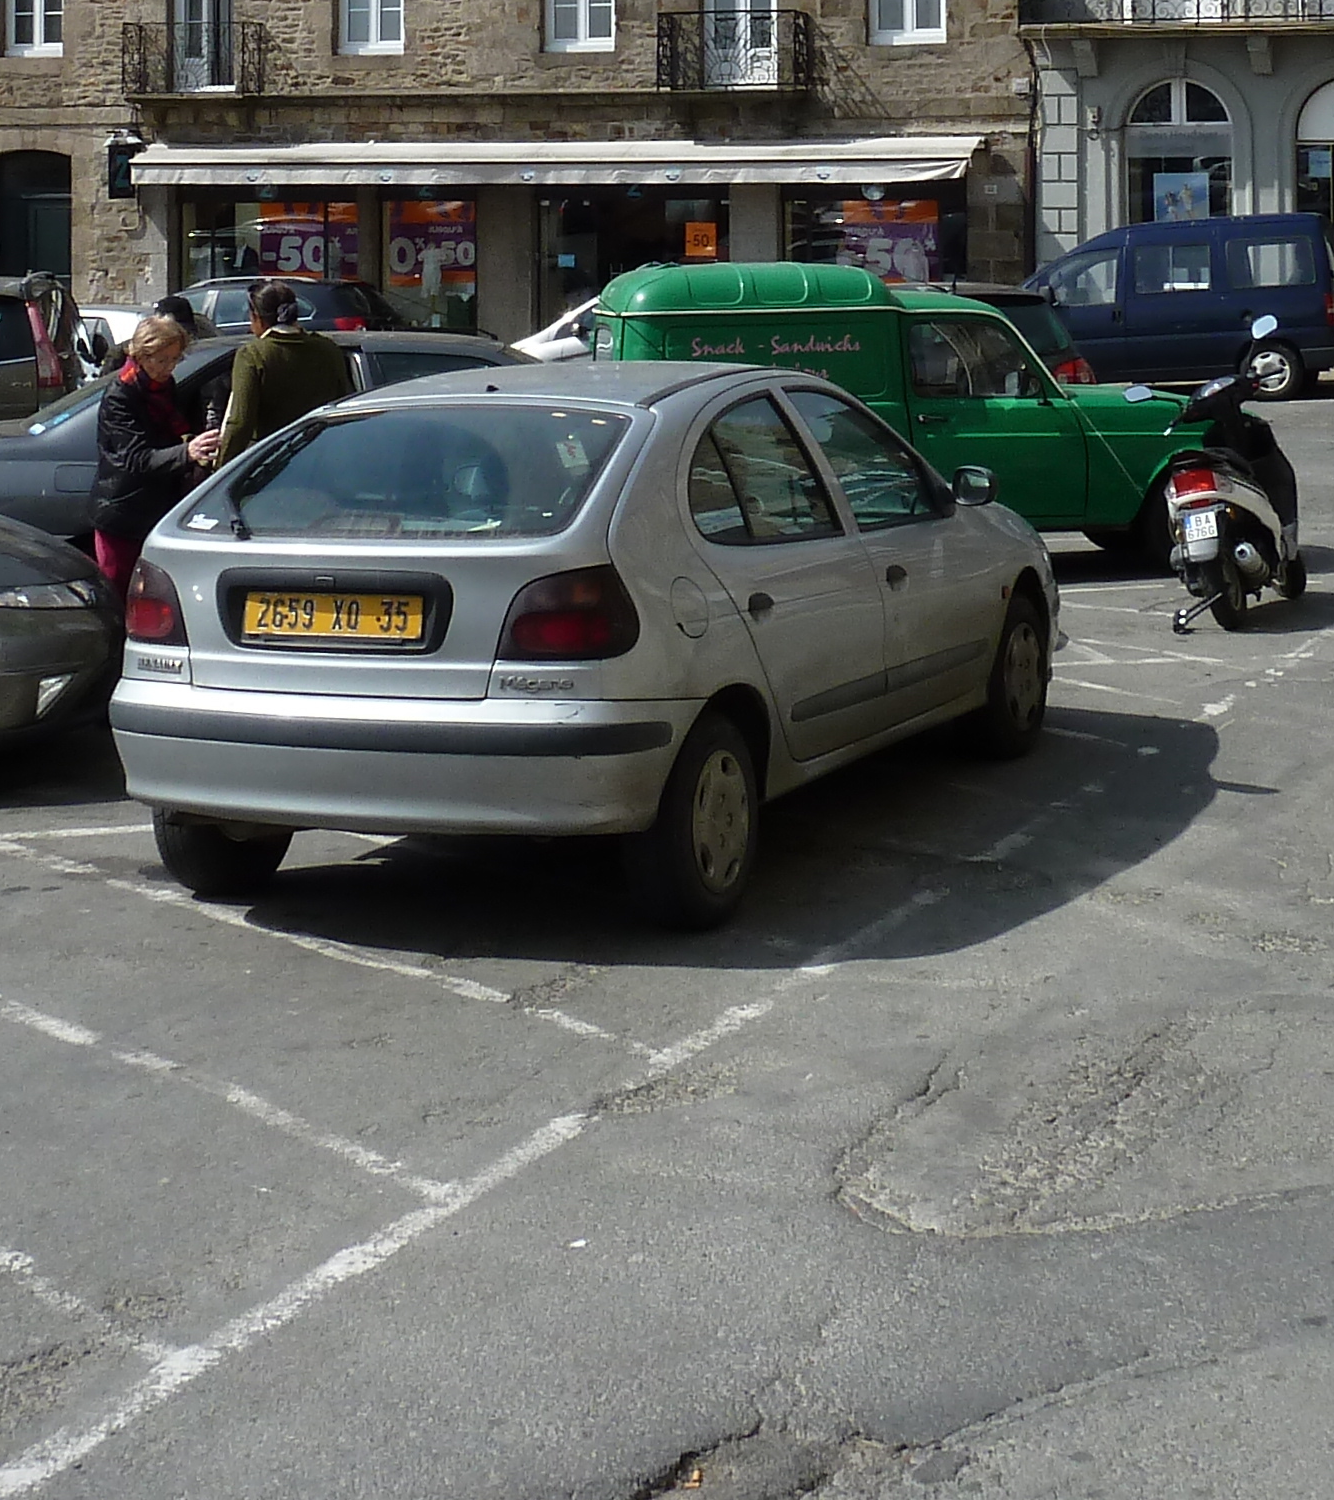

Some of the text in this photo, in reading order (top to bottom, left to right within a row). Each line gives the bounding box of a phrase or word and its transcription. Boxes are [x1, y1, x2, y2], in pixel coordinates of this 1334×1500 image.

[691, 336, 745, 357] Snack
[770, 334, 861, 355] Sandwichs
[1195, 515, 1211, 527] BA
[256, 597, 315, 631] 2659
[378, 600, 410, 633] 35
